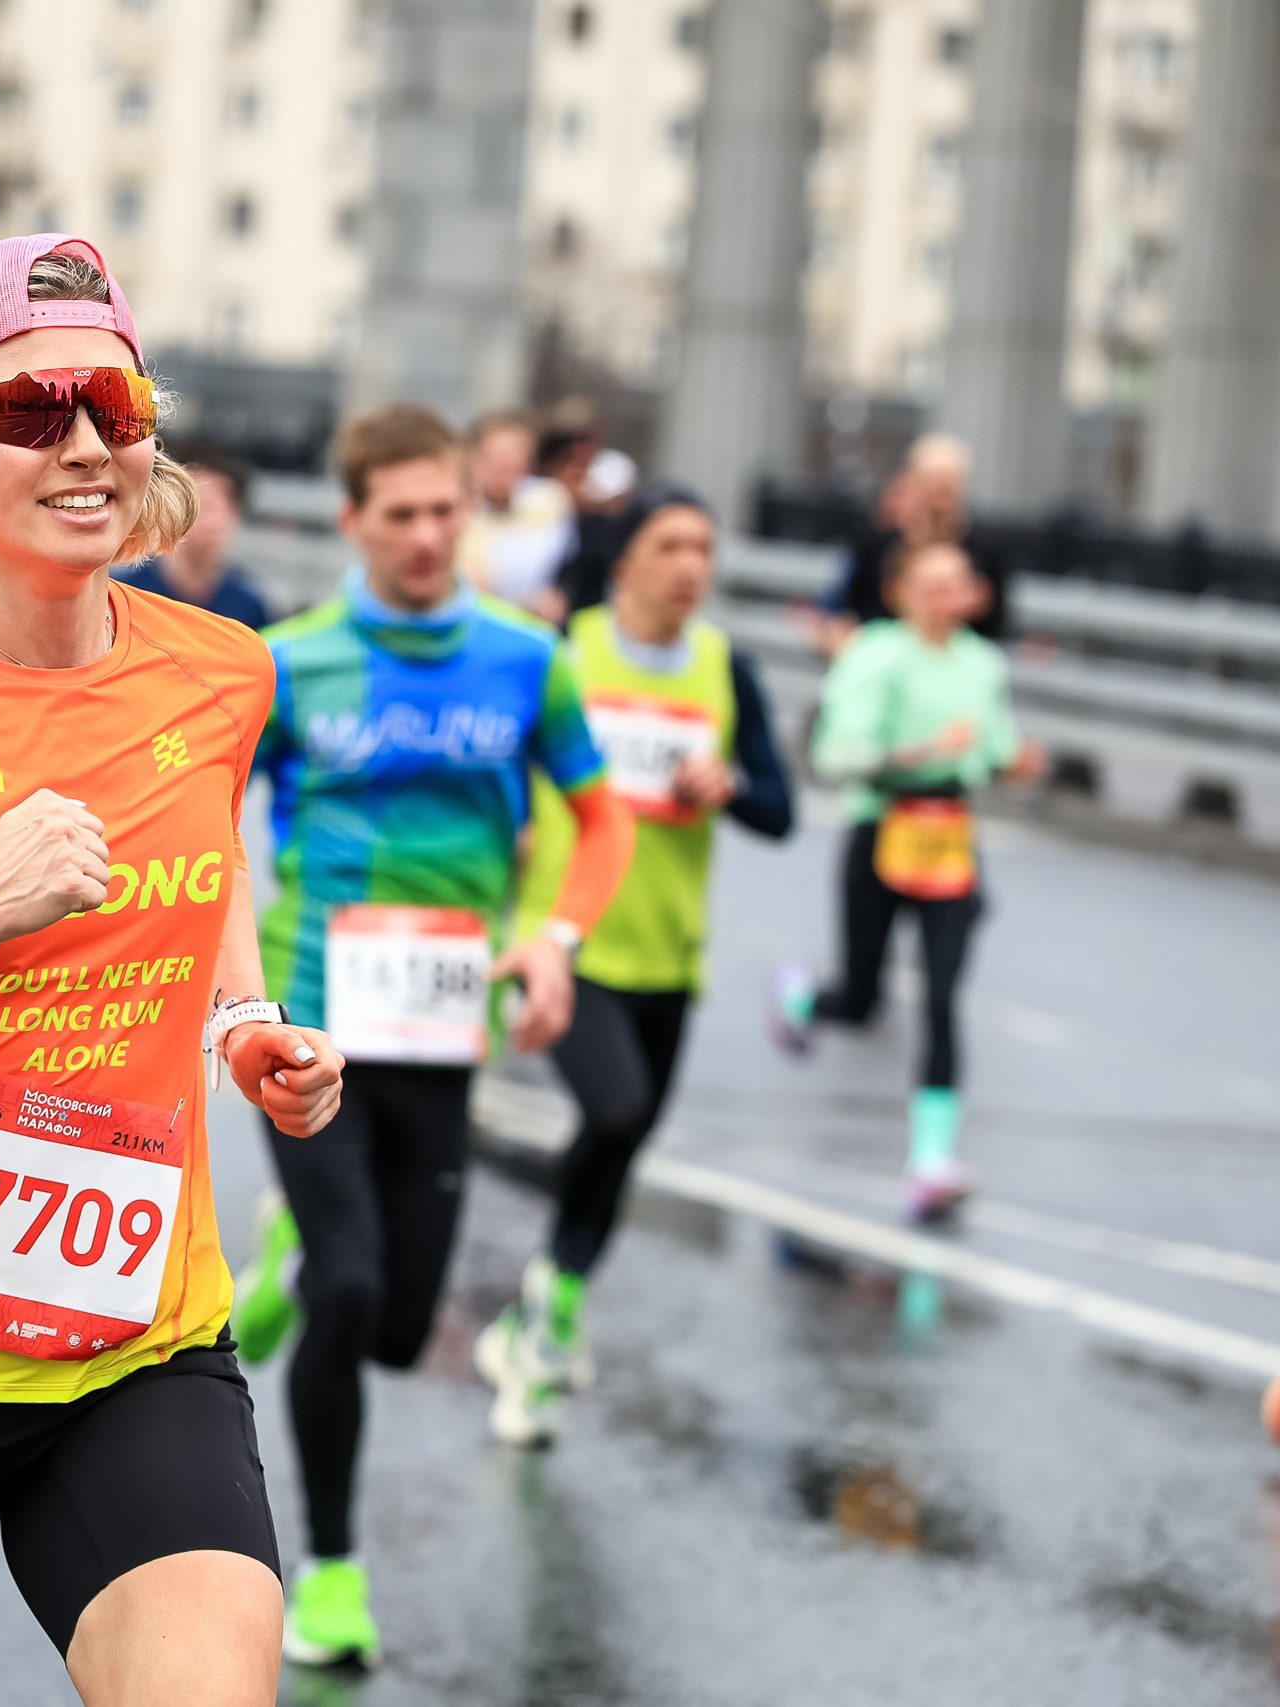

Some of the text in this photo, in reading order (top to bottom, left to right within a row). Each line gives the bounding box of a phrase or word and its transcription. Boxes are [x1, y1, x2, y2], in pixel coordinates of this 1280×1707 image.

[64, 851, 223, 920] ONG
[97, 955, 195, 989] NEVER
[99, 998, 165, 1030] RUN
[21, 1040, 131, 1073] ALONE
[16, 1115, 82, 1138] МАРАФОН
